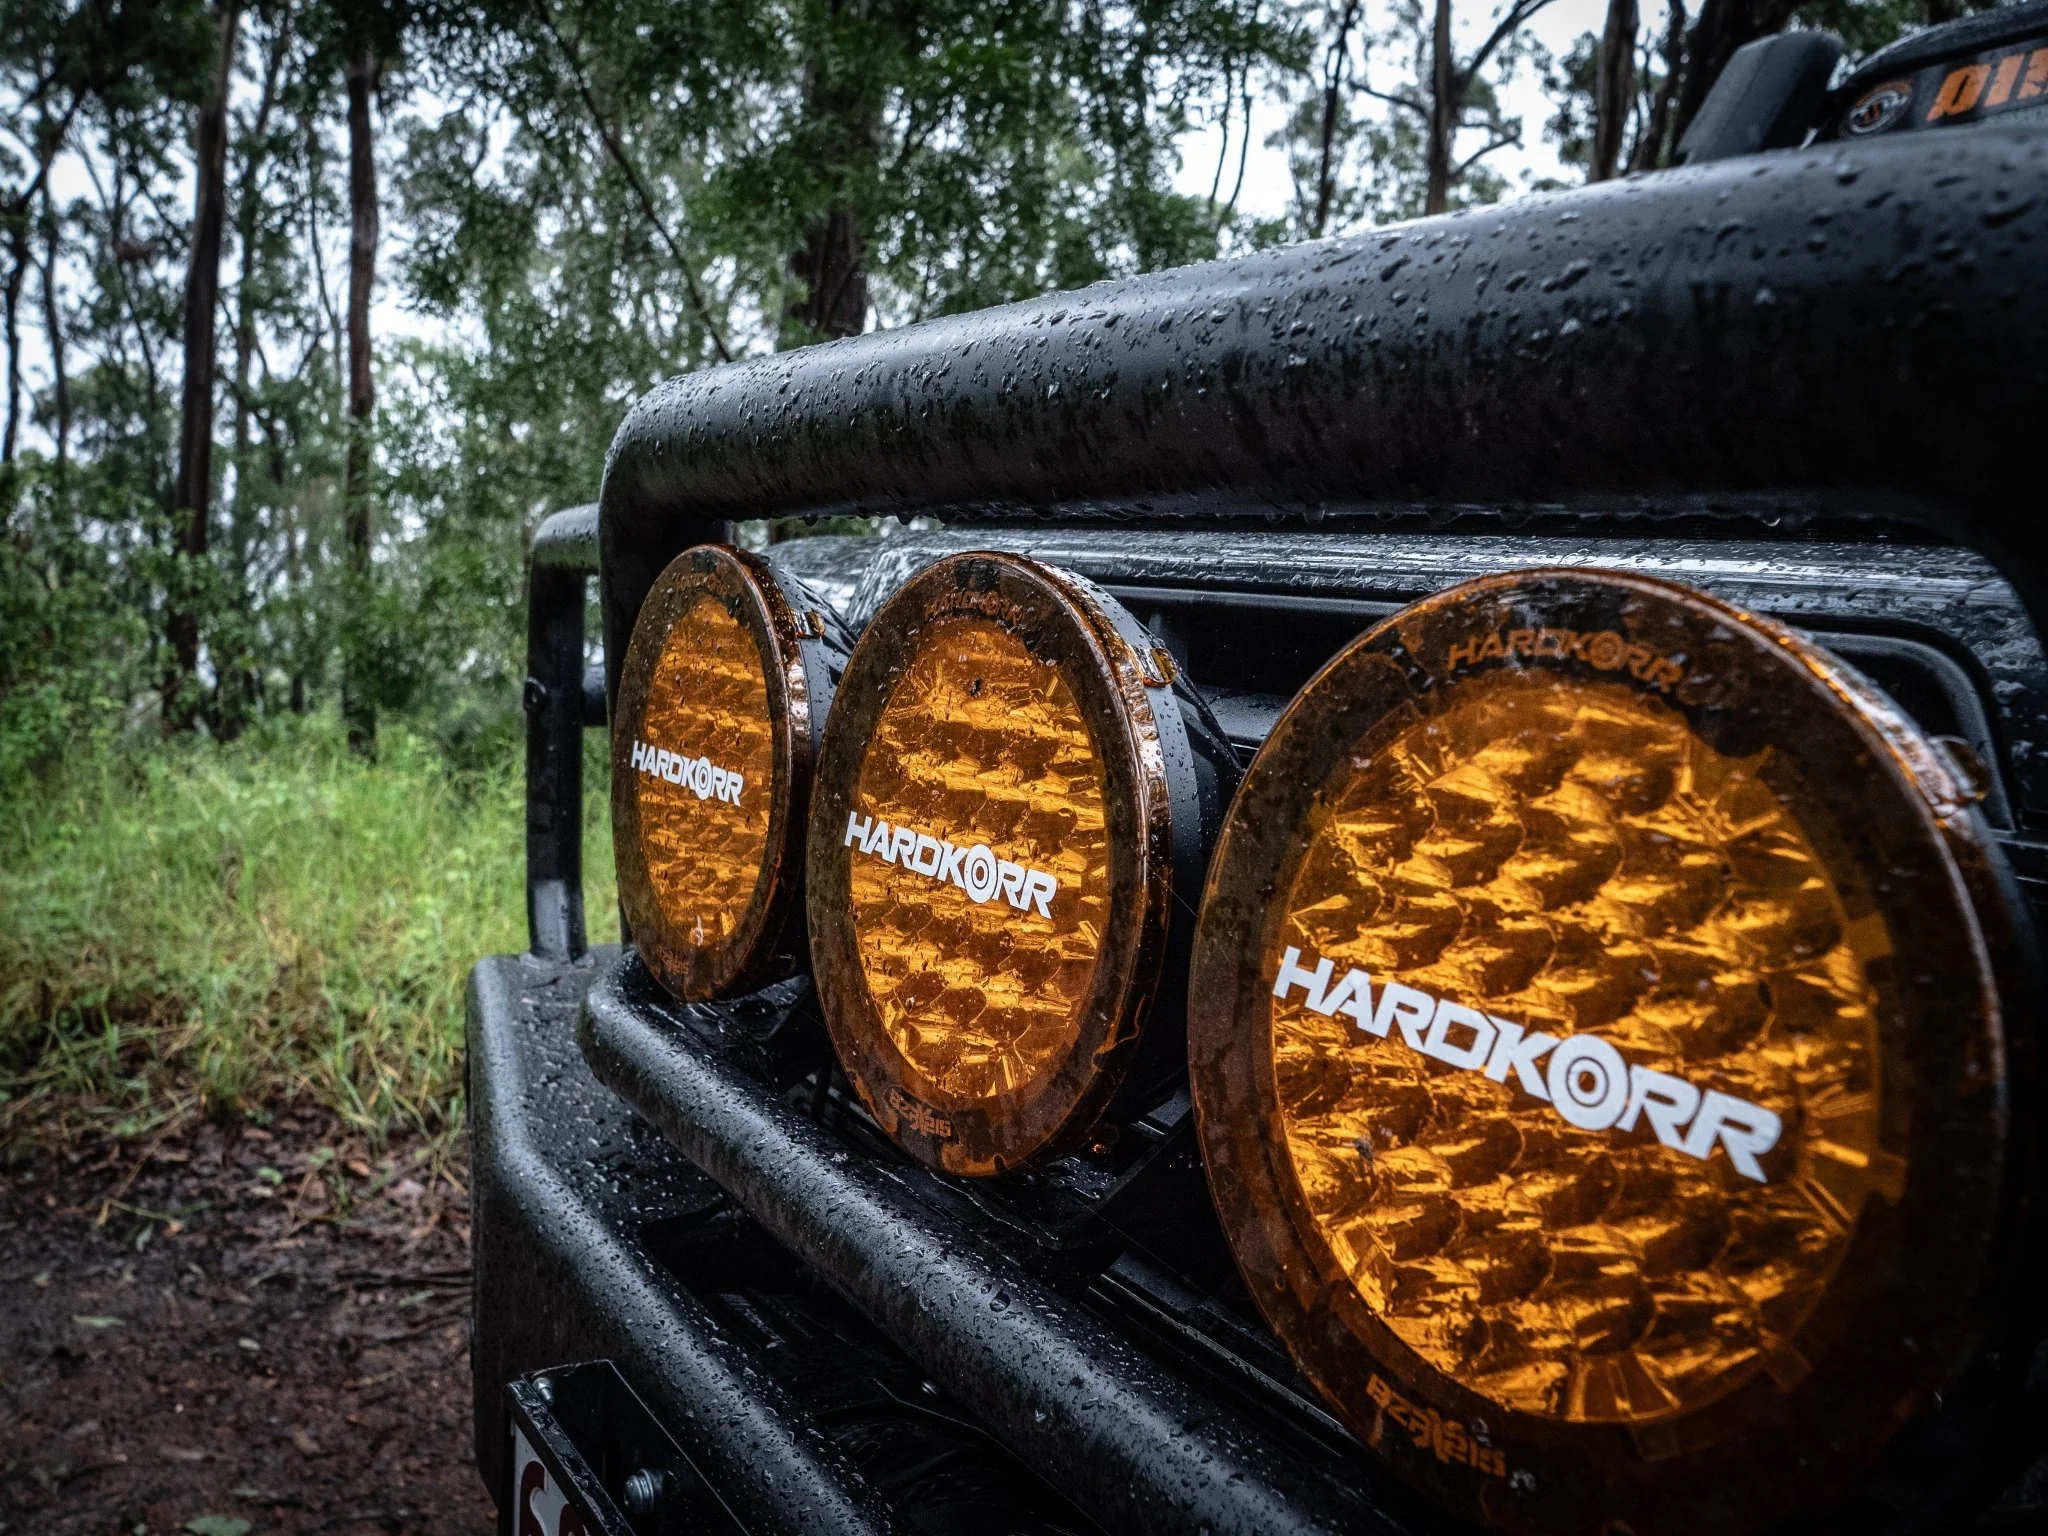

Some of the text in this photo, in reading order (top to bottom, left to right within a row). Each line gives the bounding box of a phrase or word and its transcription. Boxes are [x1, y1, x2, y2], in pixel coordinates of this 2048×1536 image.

[1450, 628, 1684, 692] HARDKORR
[631, 740, 743, 806] HARDKORR
[844, 811, 1057, 919] HARDKORR
[1273, 946, 1782, 1183] HARDKORR
